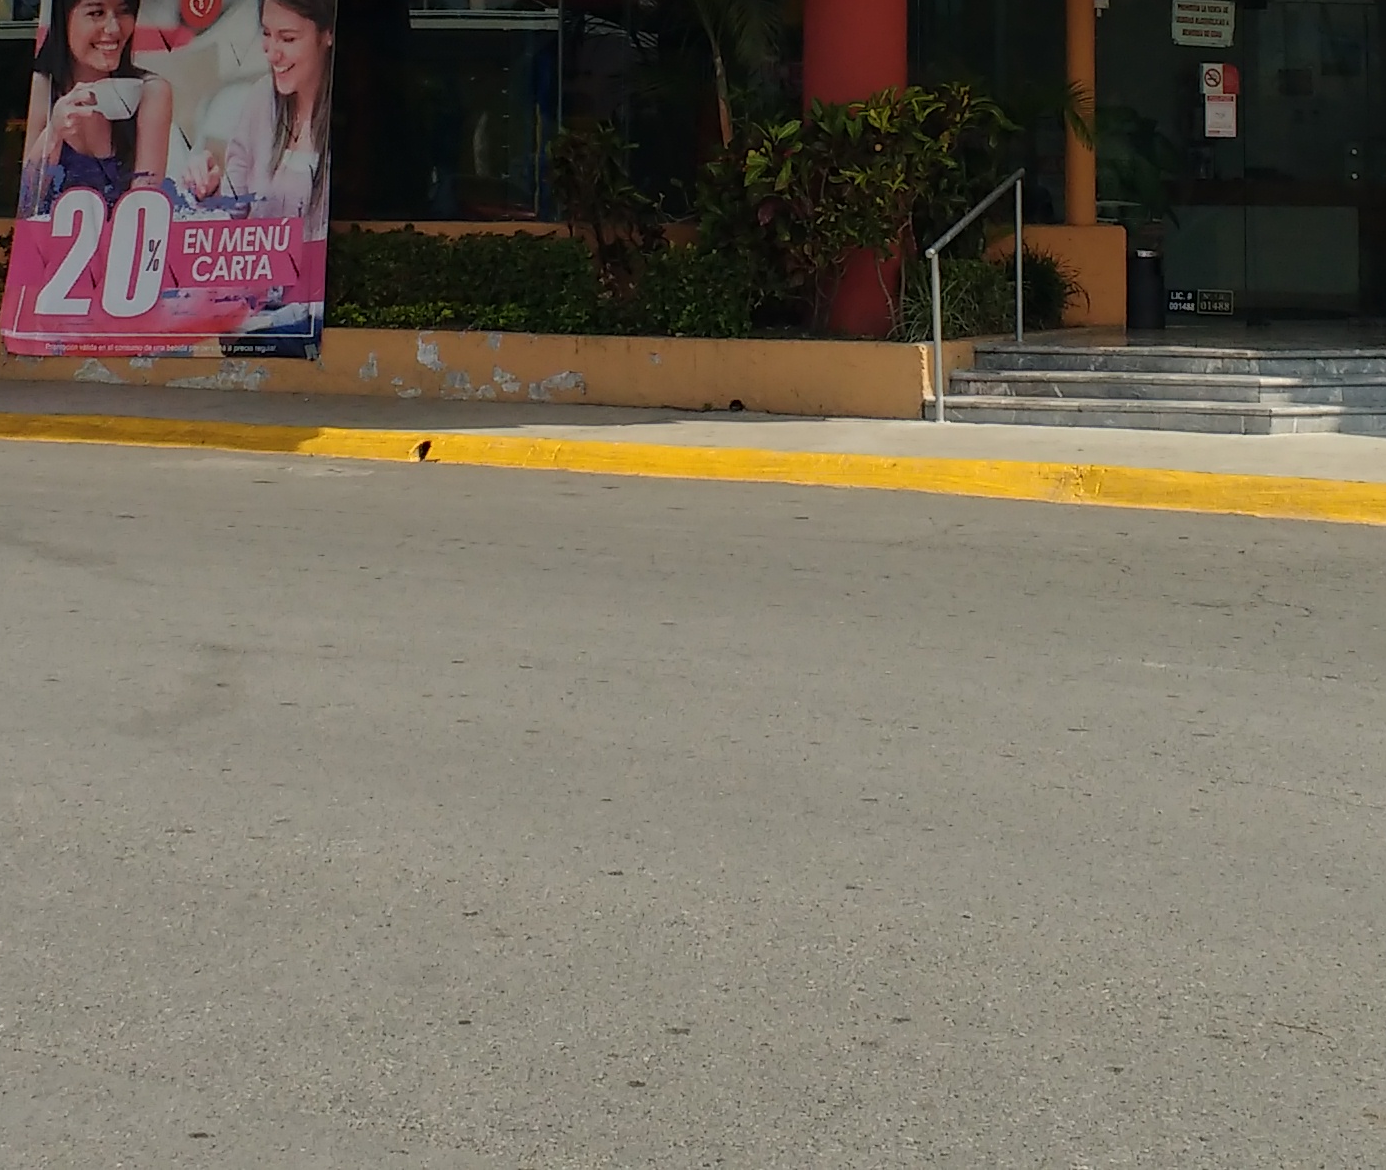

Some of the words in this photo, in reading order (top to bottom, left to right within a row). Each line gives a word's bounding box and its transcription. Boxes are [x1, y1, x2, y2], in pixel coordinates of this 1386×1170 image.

[182, 228, 214, 255] EN
[217, 218, 292, 254] MENÚ
[191, 254, 274, 283] CARTA
